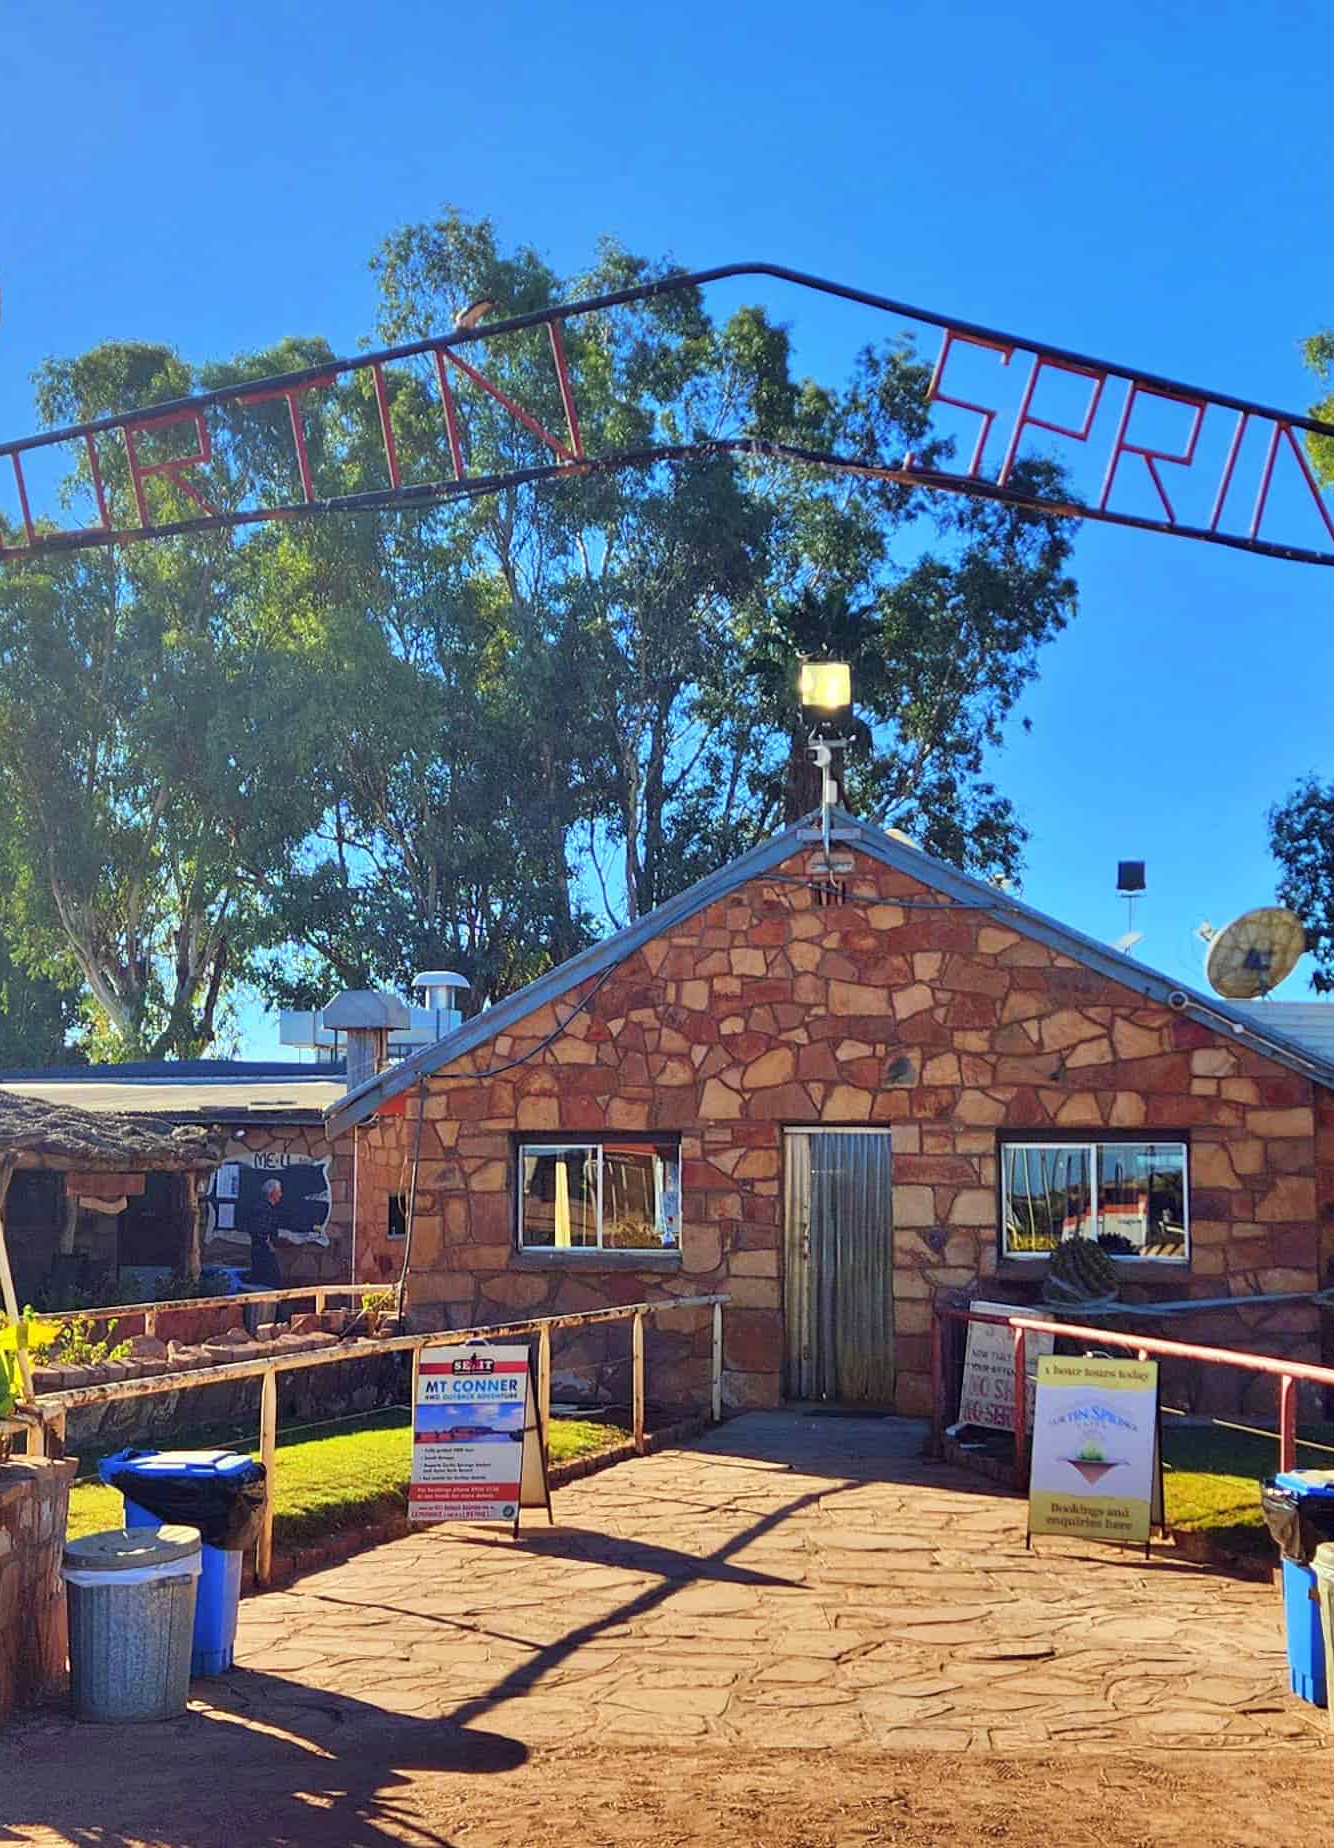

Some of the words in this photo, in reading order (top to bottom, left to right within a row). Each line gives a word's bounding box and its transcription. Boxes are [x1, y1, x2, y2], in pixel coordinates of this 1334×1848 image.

[1118, 1368, 1149, 1381] today
[425, 1381, 447, 1393] MT
[452, 1379, 518, 1393] CONNER
